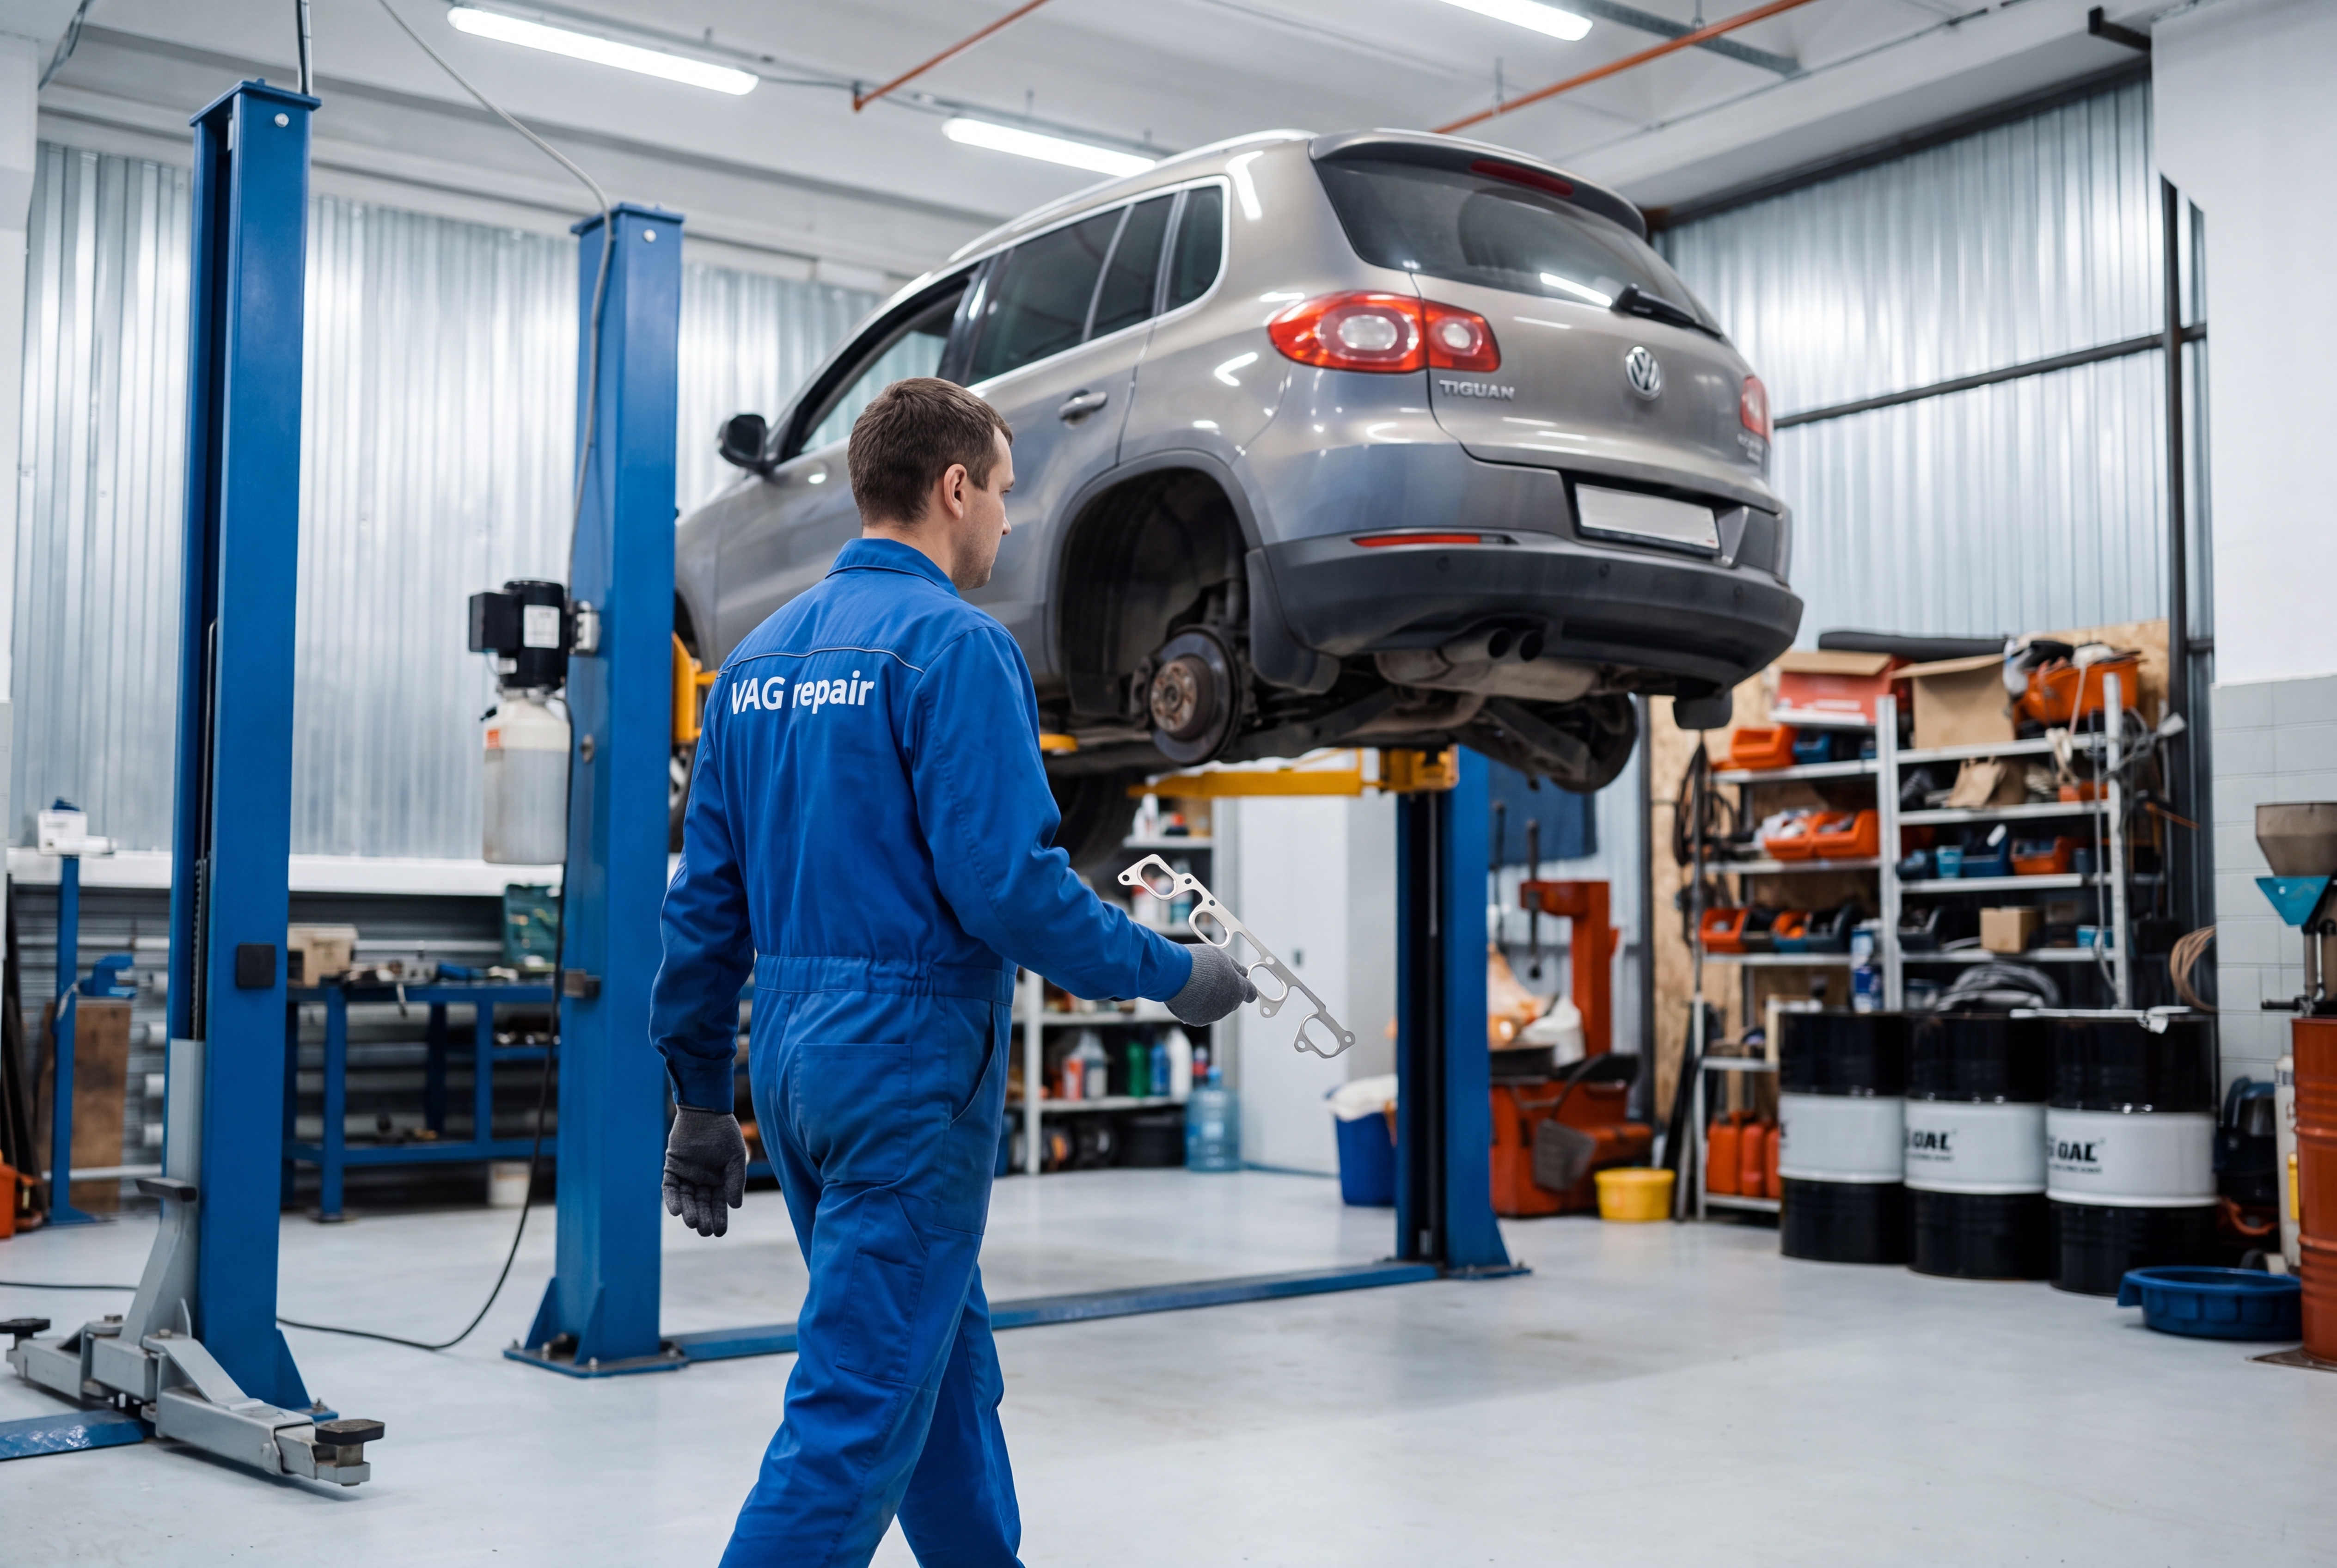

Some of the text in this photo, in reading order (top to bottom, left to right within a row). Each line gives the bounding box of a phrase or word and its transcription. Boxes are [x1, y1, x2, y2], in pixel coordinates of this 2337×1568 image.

[1438, 380, 1515, 400] TIGUAN
[732, 670, 875, 715] VAG repair
